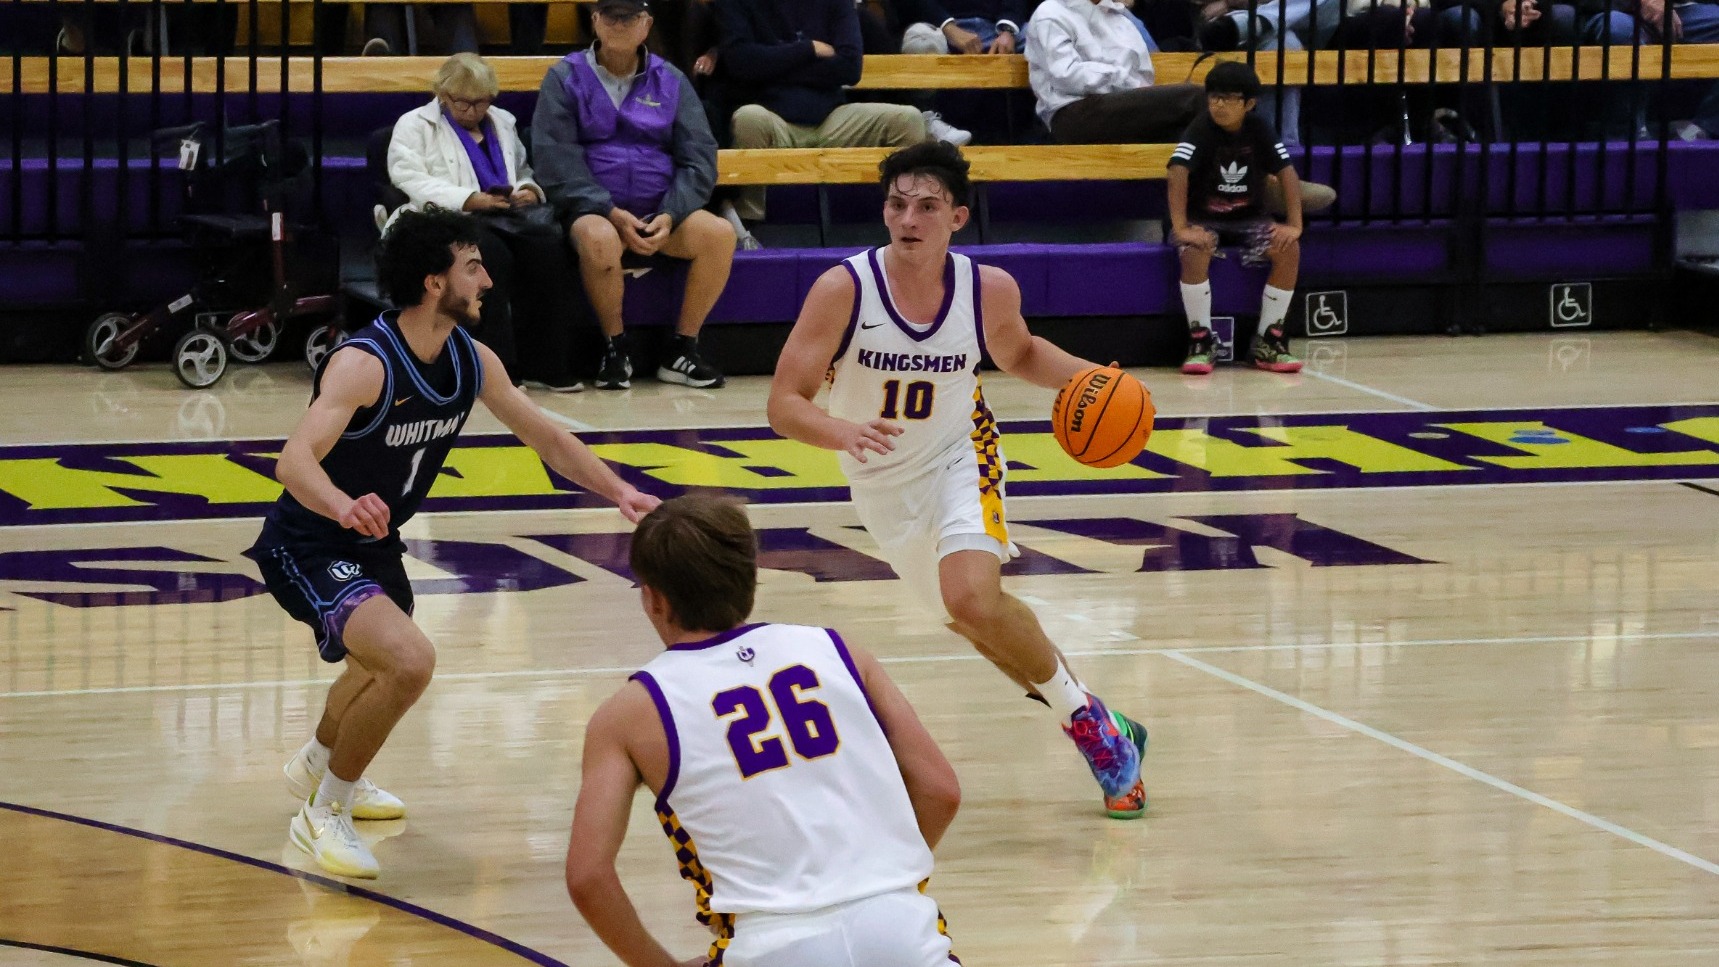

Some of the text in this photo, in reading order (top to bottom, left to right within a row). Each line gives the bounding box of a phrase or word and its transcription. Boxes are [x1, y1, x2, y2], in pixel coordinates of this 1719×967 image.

[858, 348, 967, 373] KINGSMEN
[880, 379, 935, 420] 10
[1071, 374, 1111, 432] Wilson
[401, 447, 426, 497] 1
[710, 662, 842, 782] 26
